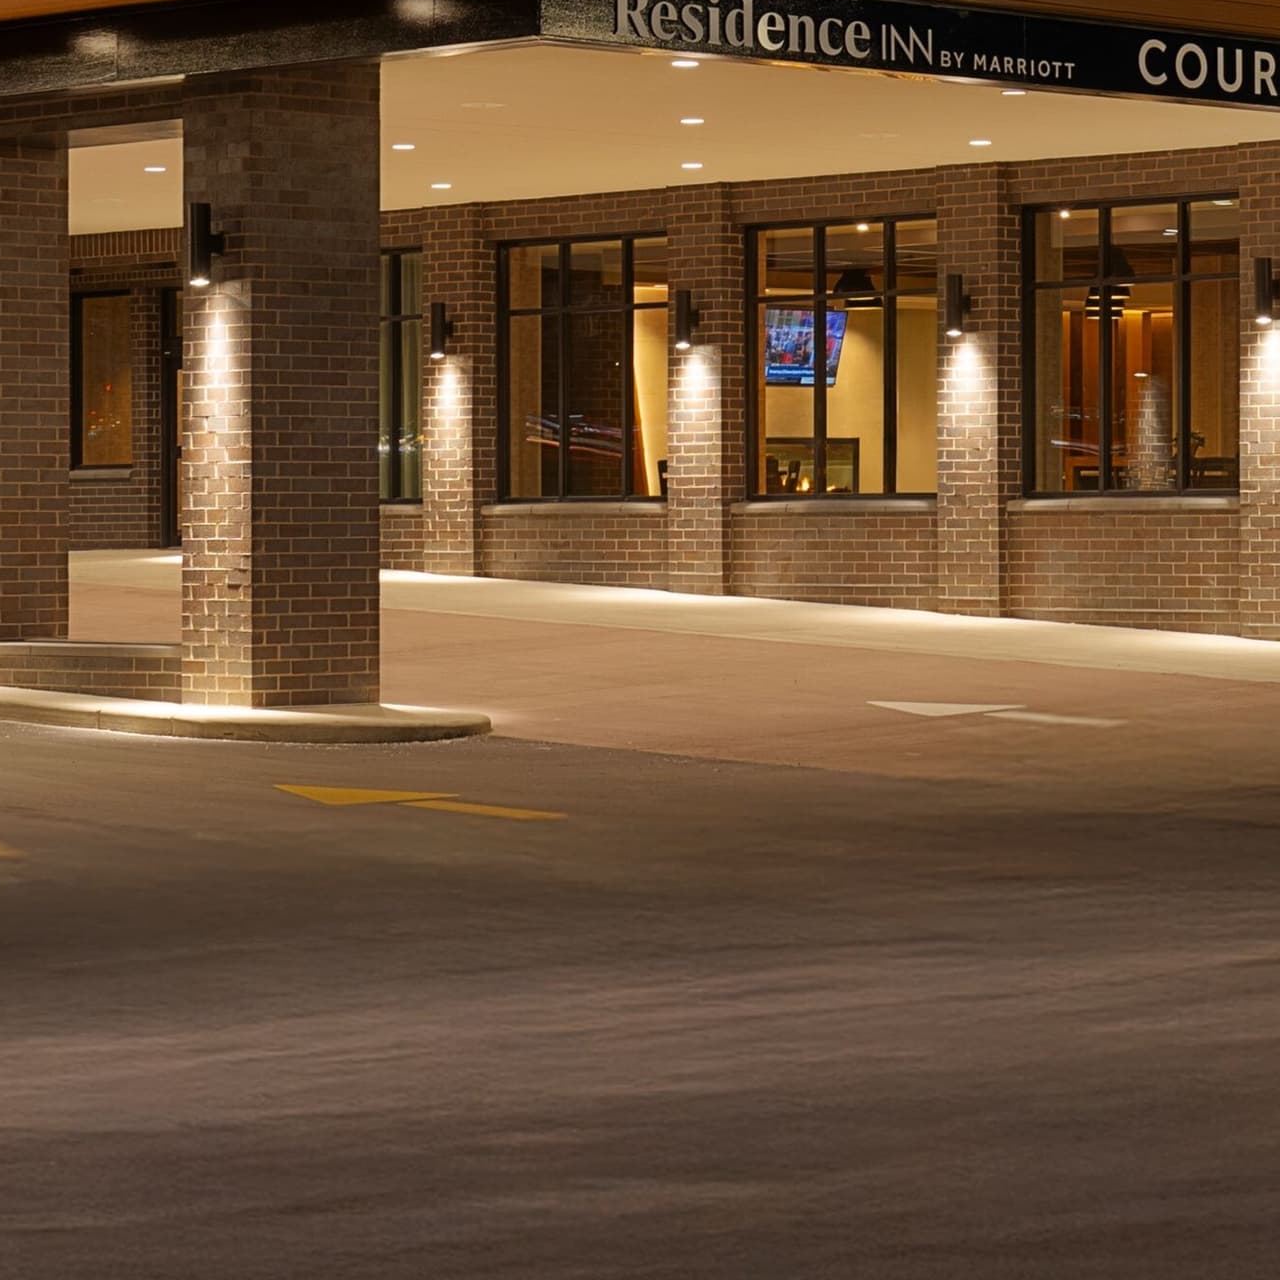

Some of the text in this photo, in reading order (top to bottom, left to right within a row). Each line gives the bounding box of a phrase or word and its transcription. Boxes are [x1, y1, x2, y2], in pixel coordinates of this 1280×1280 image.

[880, 24, 934, 66] INN
[939, 50, 965, 70] BY
[972, 53, 1077, 80] MARRIOTT
